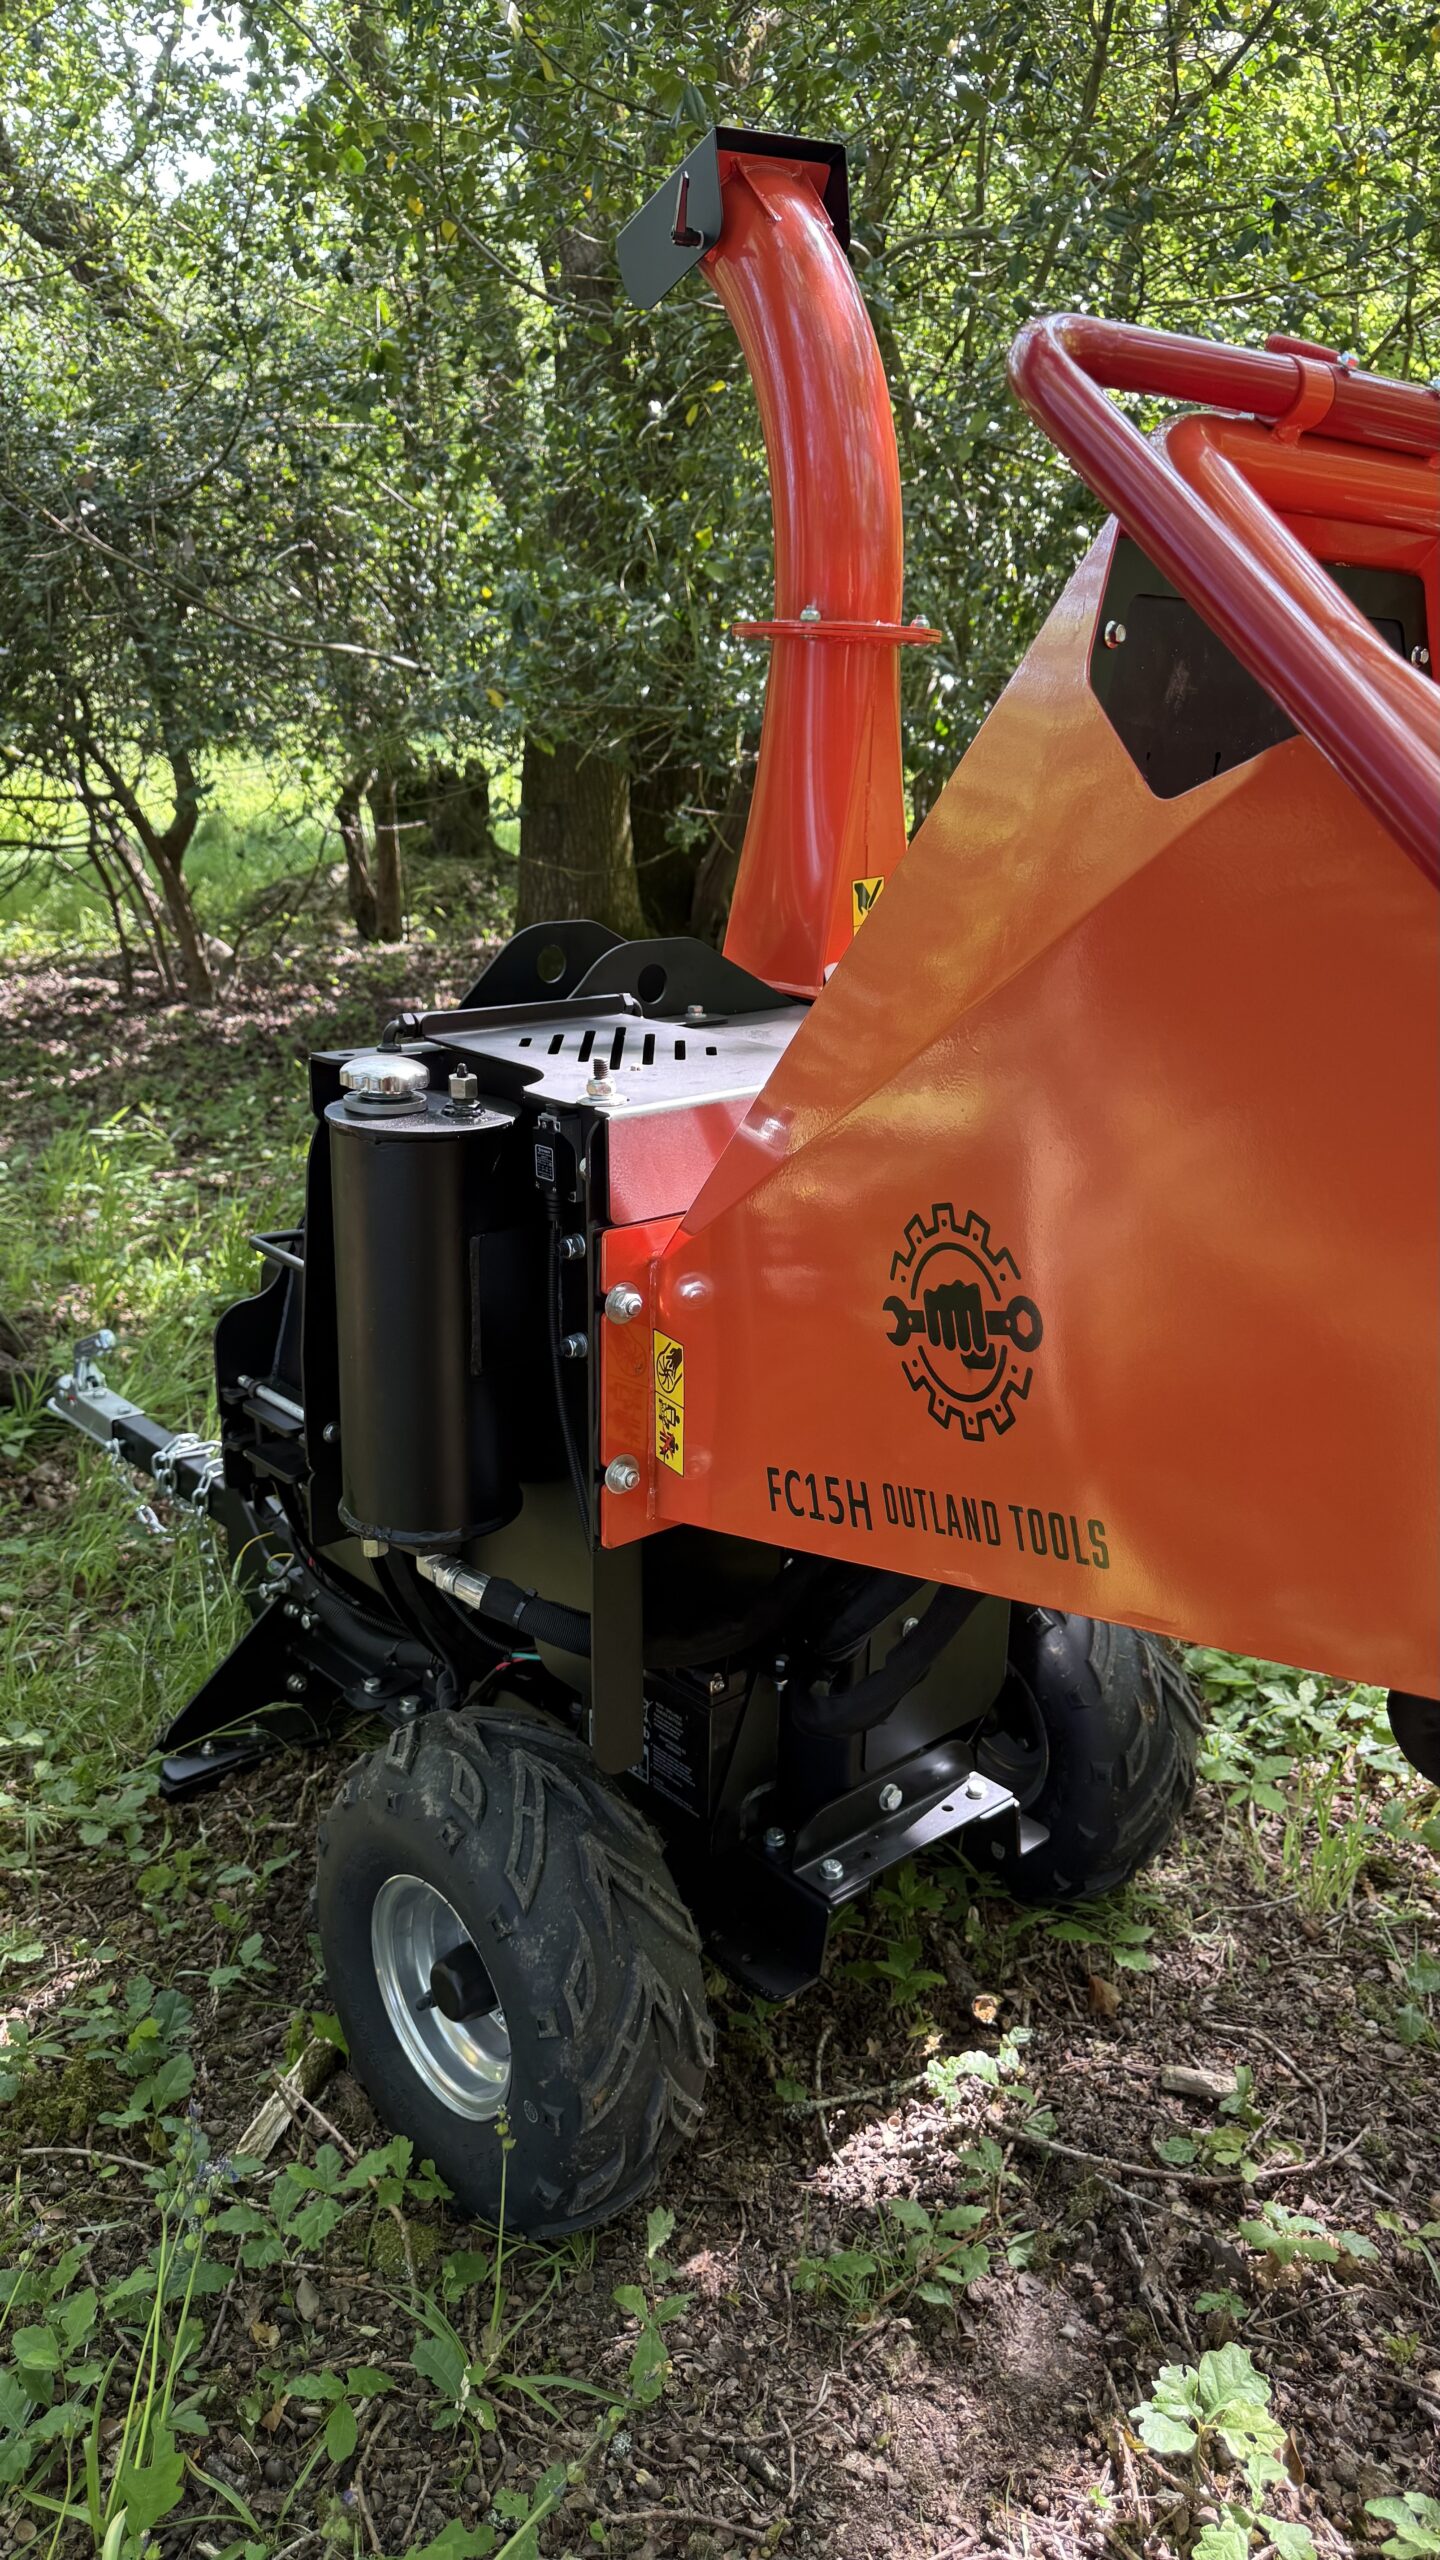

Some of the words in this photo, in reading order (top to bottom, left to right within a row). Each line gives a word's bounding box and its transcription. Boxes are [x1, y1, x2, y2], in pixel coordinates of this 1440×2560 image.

[766, 1466, 874, 1531] FC15H
[882, 1482, 1001, 1547] OUTLAND
[1008, 1503, 1111, 1570] TOOLS
